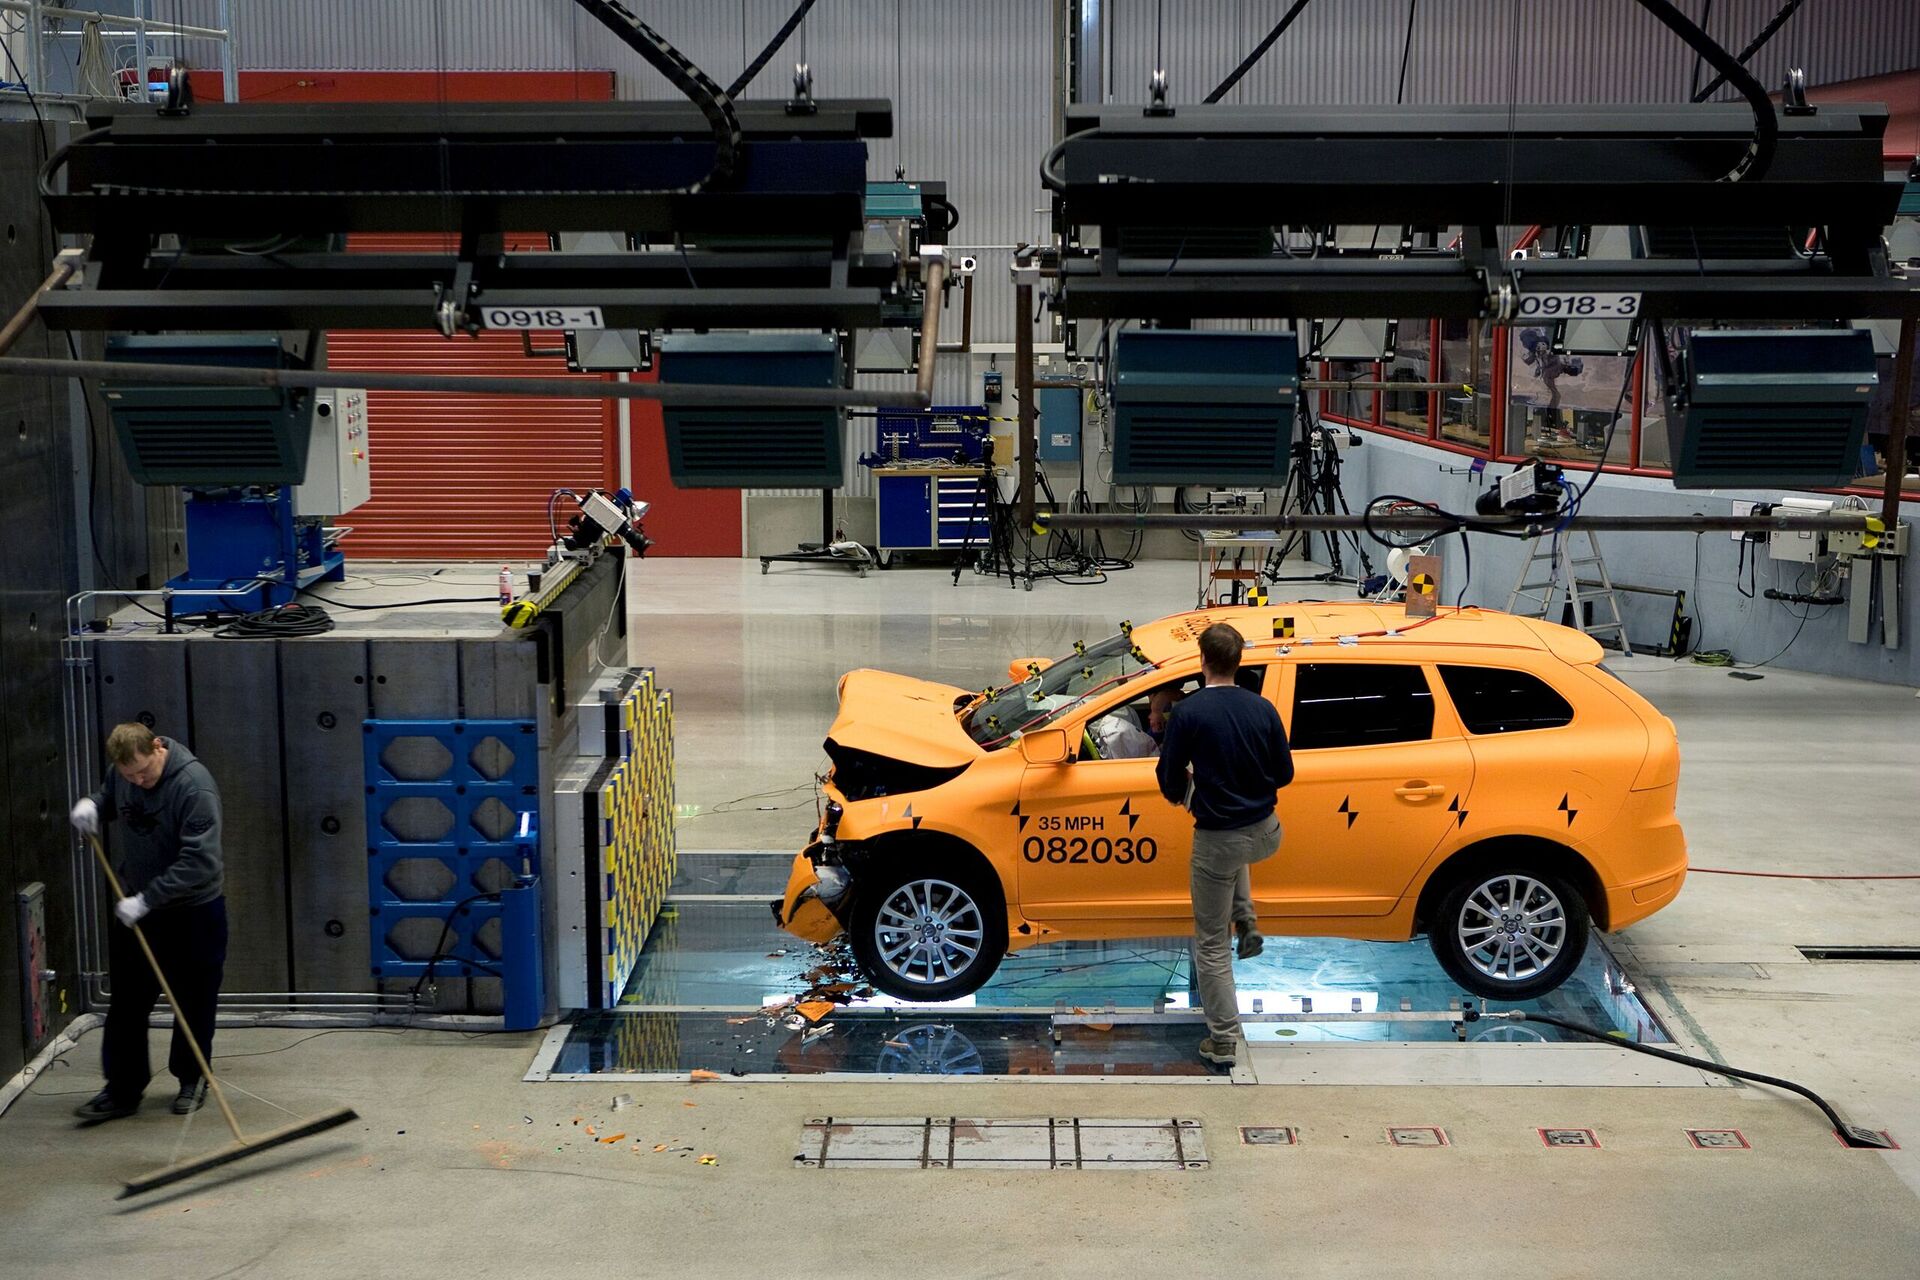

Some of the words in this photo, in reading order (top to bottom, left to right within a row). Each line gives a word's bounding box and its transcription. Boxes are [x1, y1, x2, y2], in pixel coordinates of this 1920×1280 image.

[1520, 296, 1637, 315] 0918-3
[490, 310, 598, 327] 0918-1
[1038, 816, 1061, 831] 35
[1065, 816, 1104, 830] MPH
[1023, 836, 1157, 864] 082030
